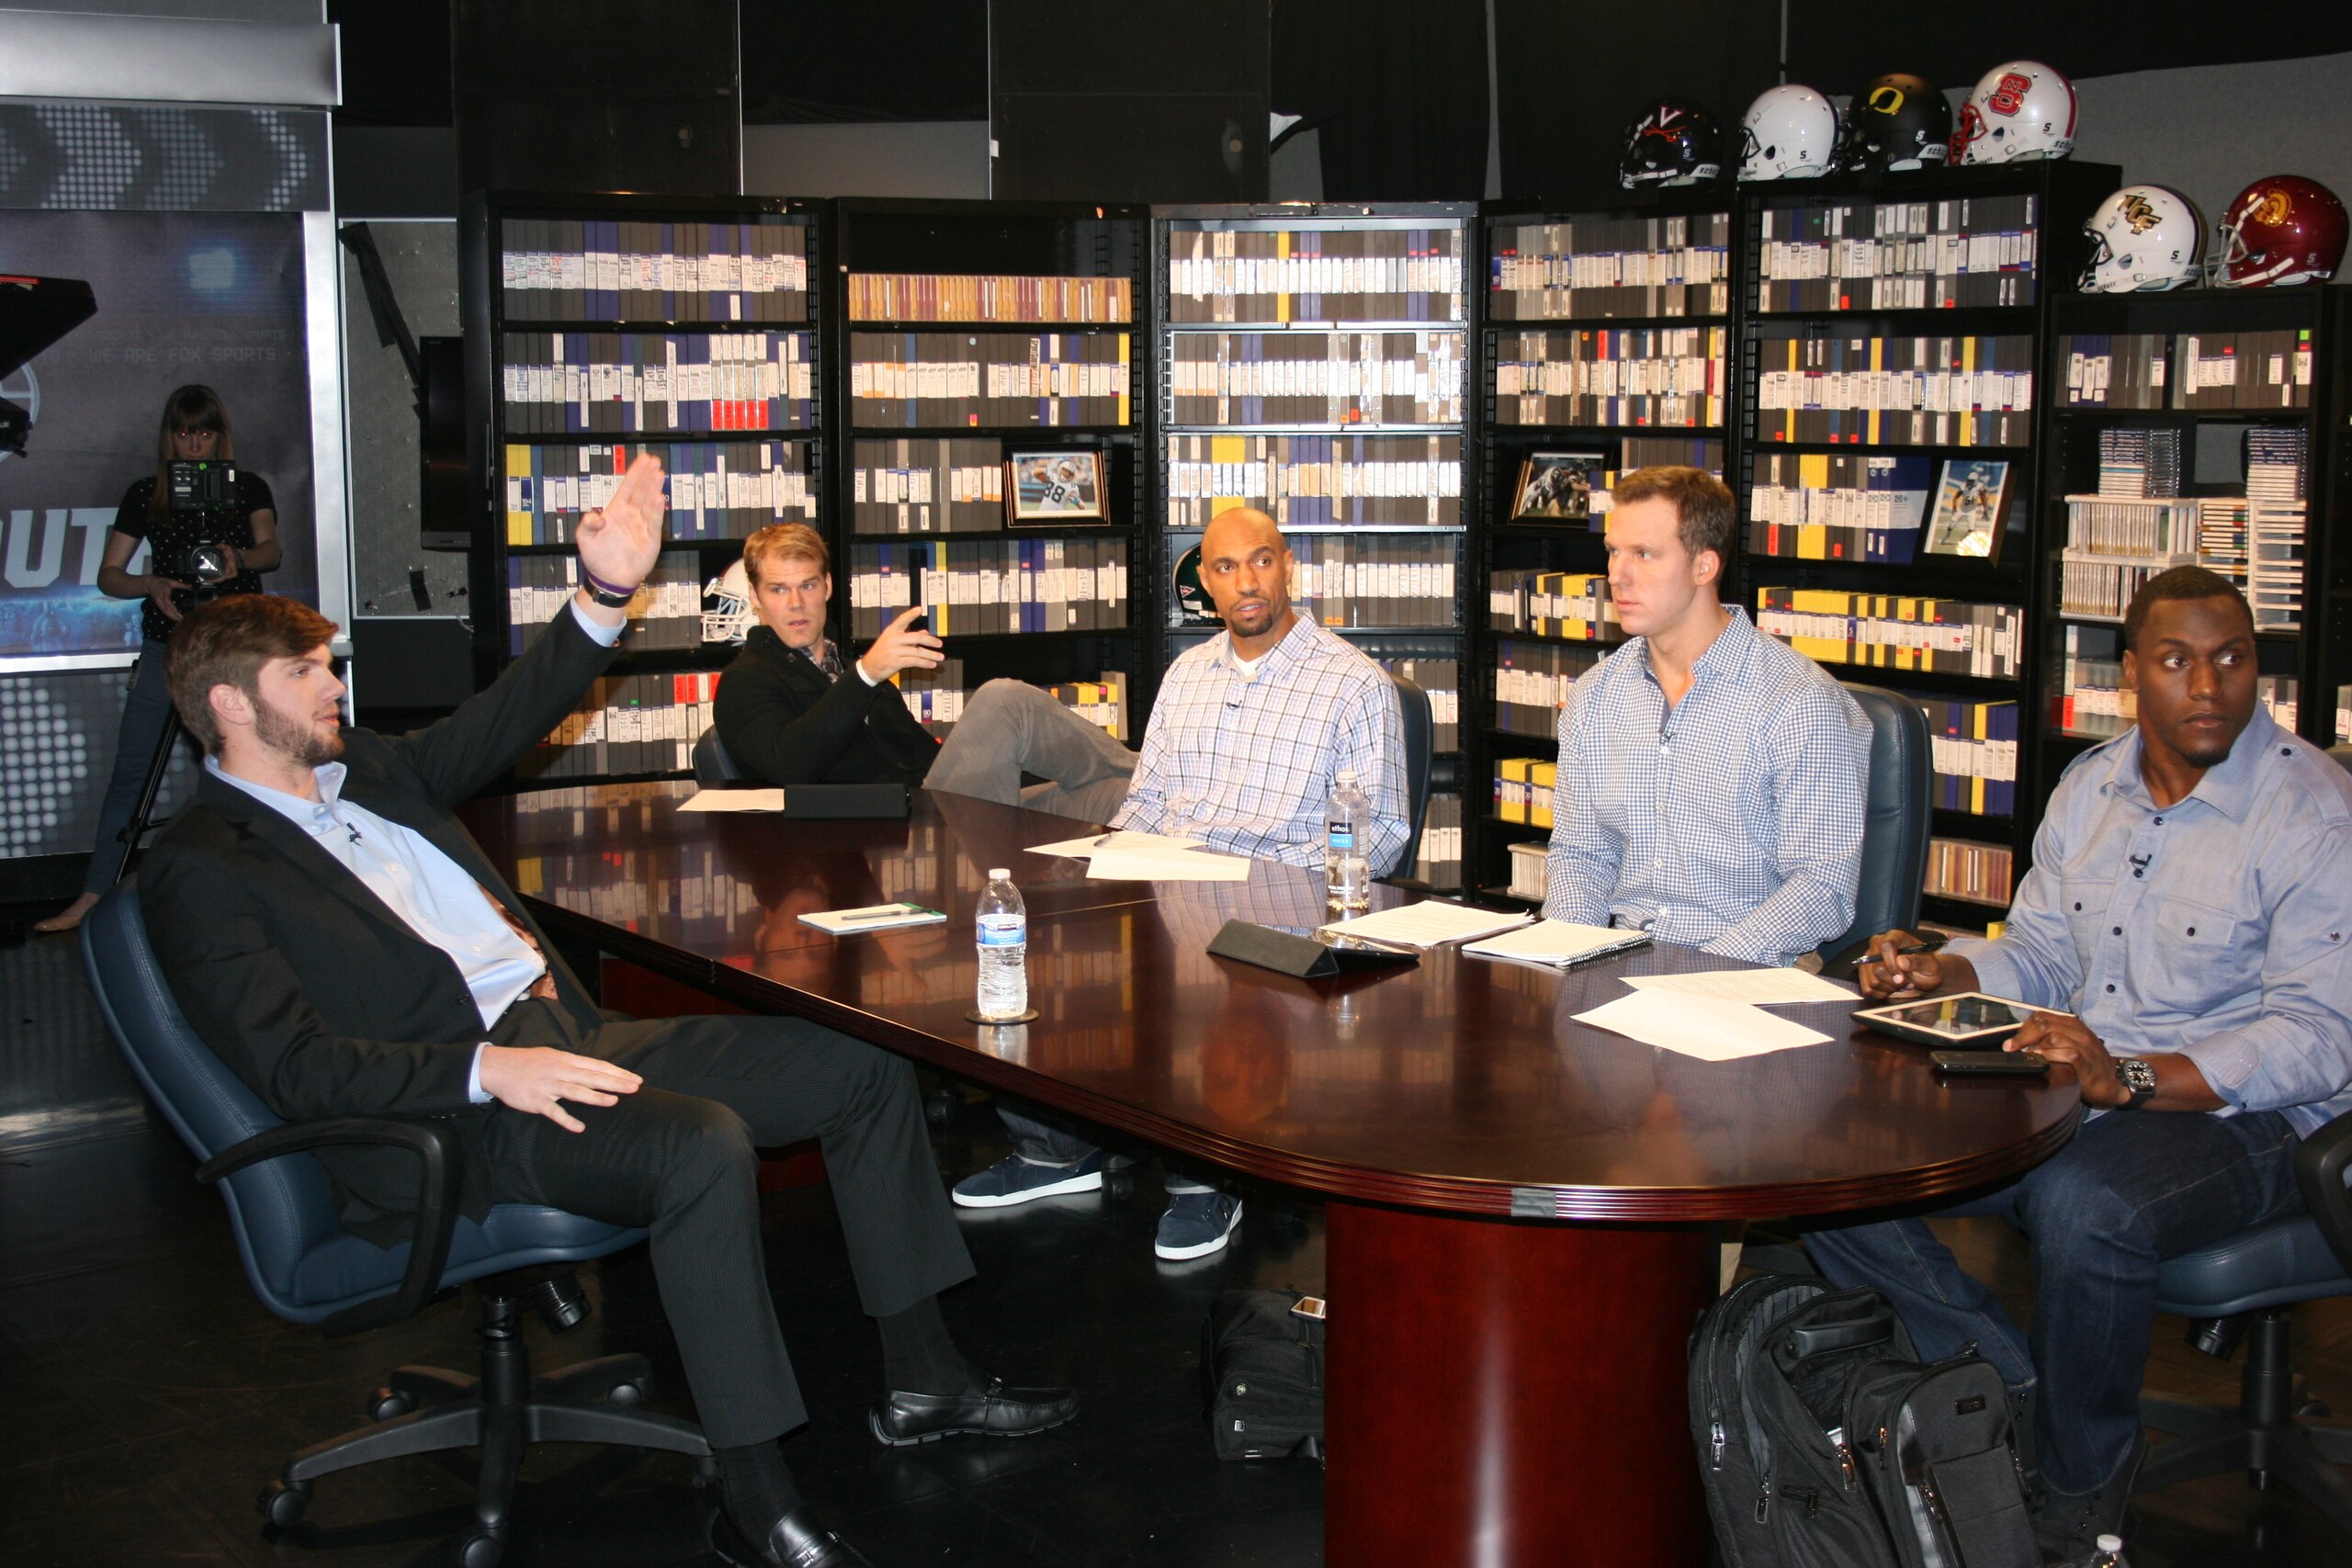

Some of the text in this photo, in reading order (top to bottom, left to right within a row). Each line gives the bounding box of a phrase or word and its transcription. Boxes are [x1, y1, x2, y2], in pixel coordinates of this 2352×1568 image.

[1659, 106, 1685, 129] V
[89, 346, 277, 363] WE ARE FOX SPORTS
